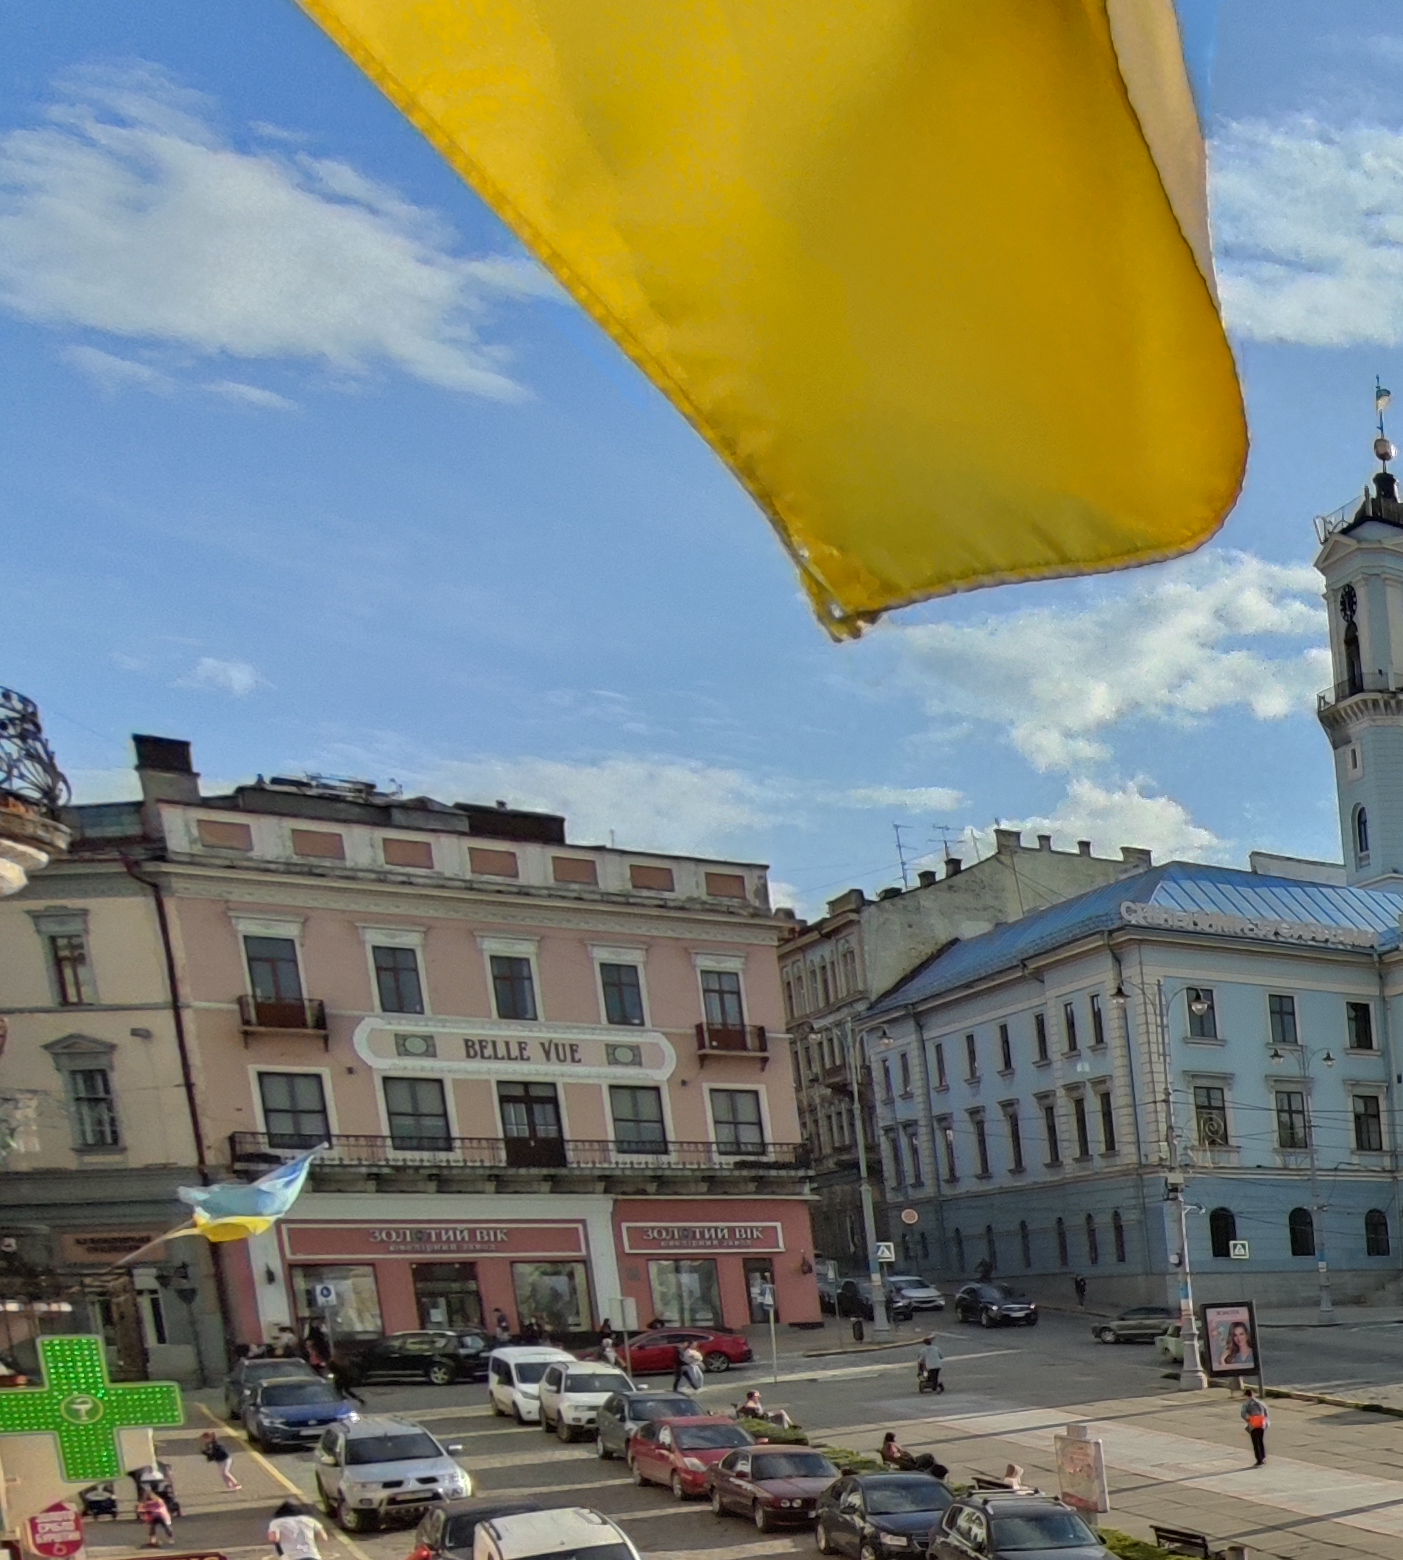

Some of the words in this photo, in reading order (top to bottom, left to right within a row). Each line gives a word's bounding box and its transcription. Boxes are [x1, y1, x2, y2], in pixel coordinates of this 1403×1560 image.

[463, 1038, 531, 1062] BELLE
[540, 1041, 582, 1063] VUE
[475, 1229, 508, 1242] ВІК
[735, 1227, 763, 1239] ВІК
